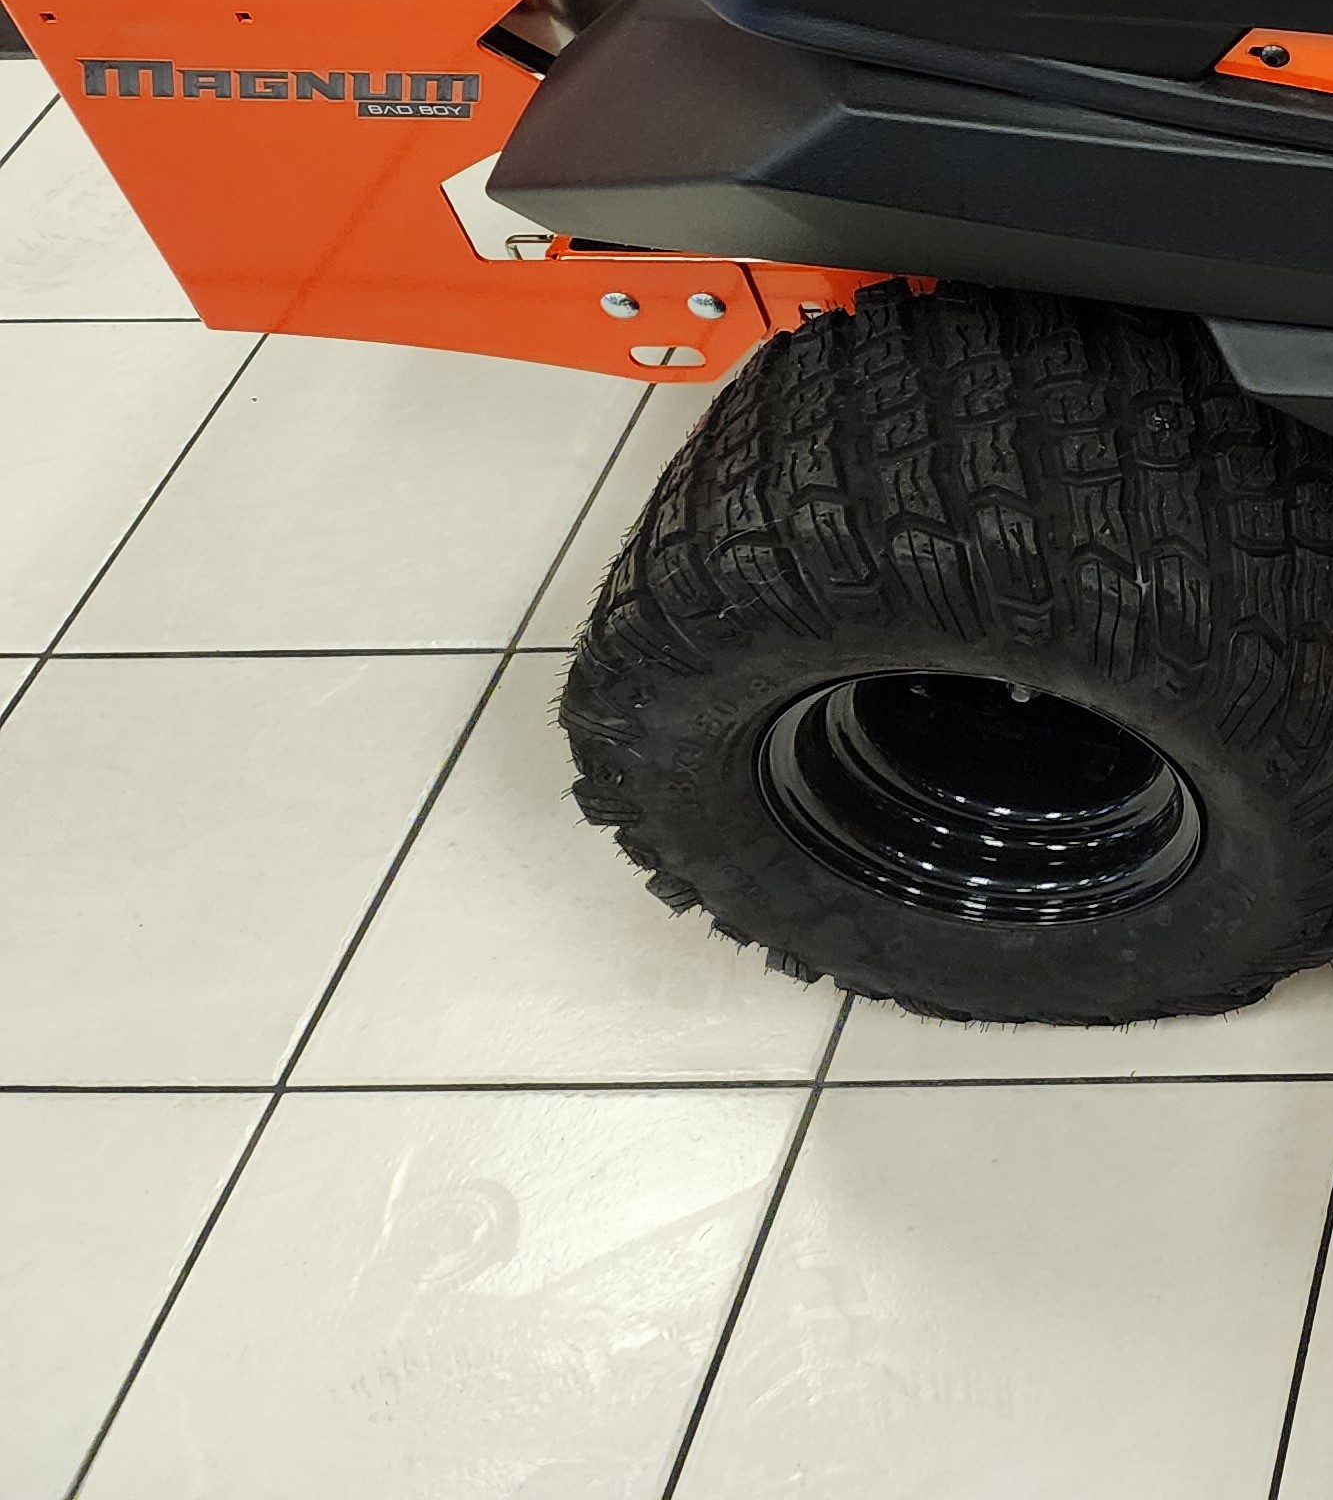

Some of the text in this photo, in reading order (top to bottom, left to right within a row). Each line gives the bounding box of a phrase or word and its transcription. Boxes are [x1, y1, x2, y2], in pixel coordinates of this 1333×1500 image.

[76, 58, 480, 102] MAGNUM
[368, 104, 463, 116] BAD BOY
